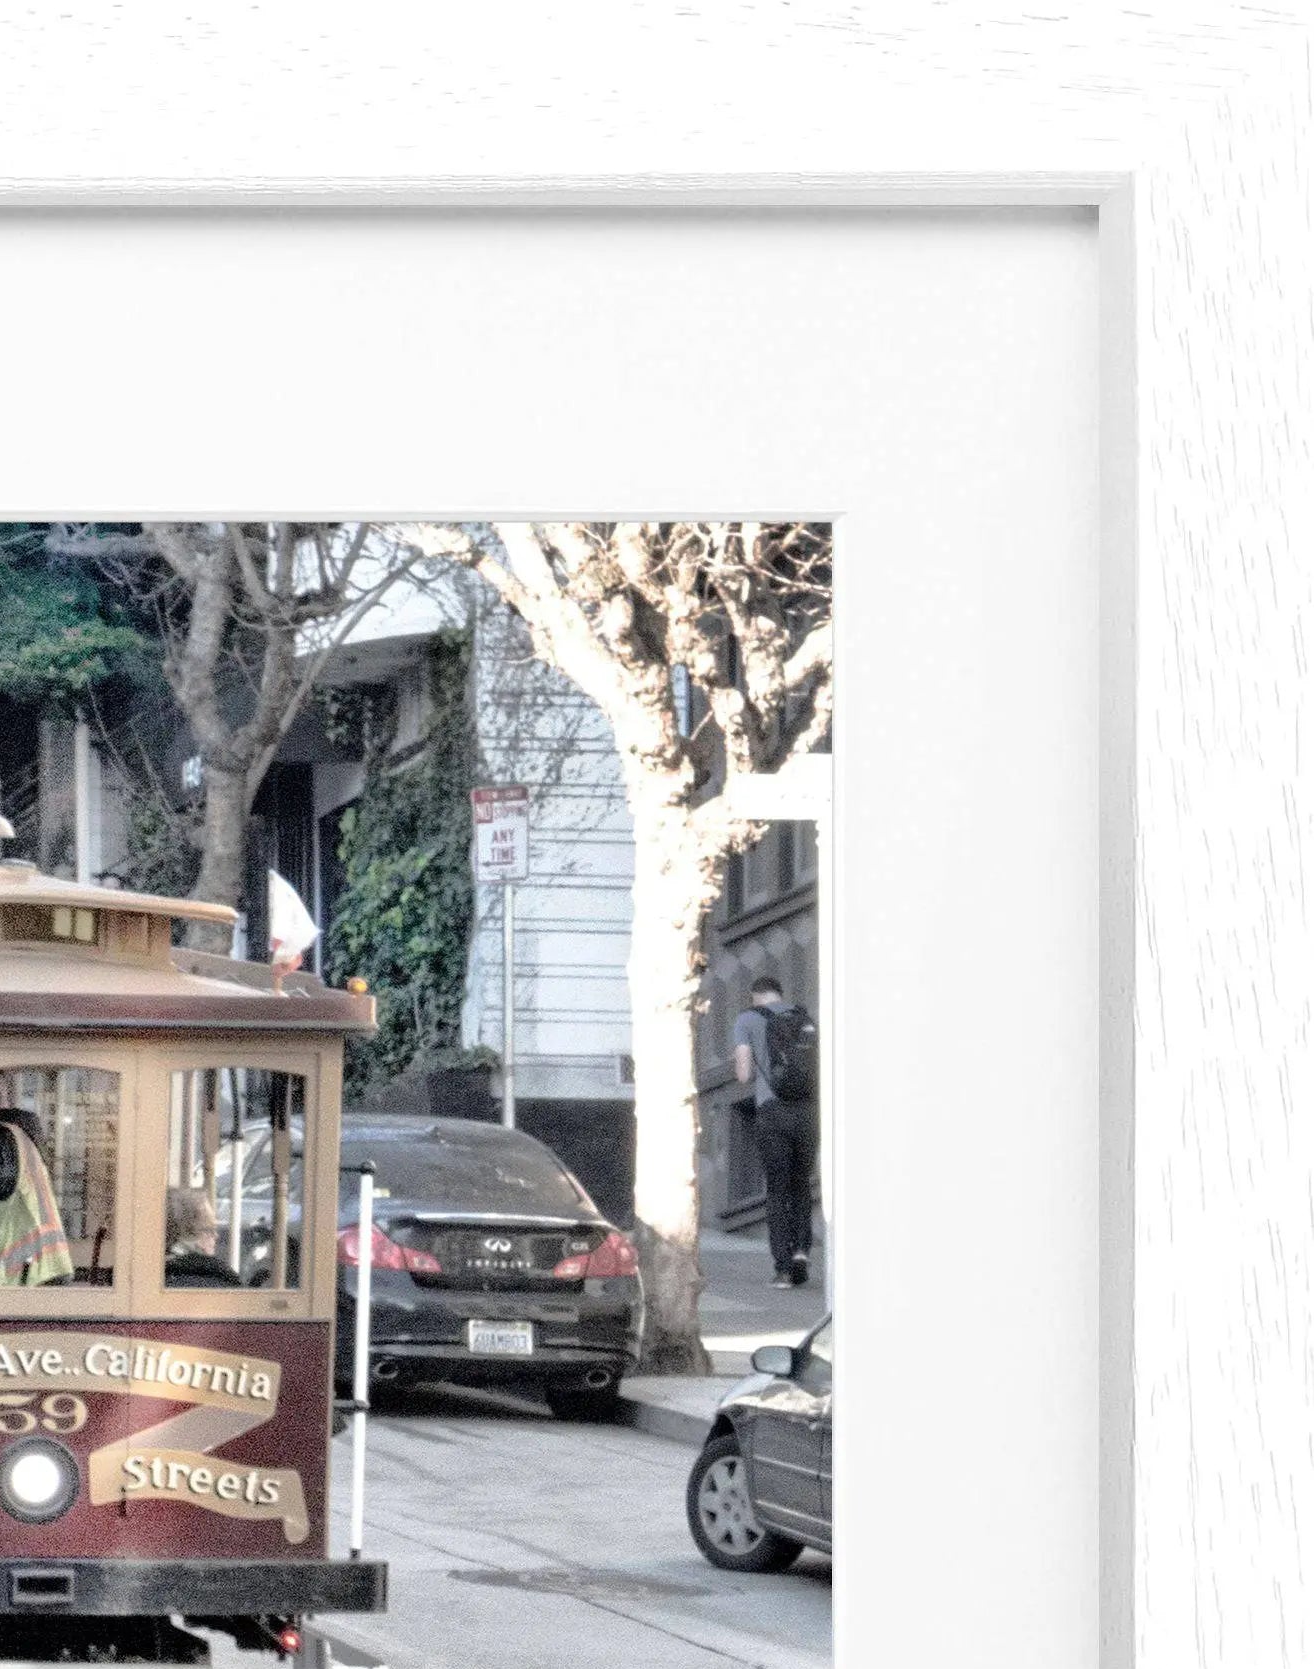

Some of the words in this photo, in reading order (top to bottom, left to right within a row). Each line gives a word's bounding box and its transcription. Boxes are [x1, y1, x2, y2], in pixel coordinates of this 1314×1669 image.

[492, 829, 515, 844] ANY
[491, 846, 516, 862] TIME
[85, 1343, 272, 1401] California
[122, 1455, 283, 1504] Streets
